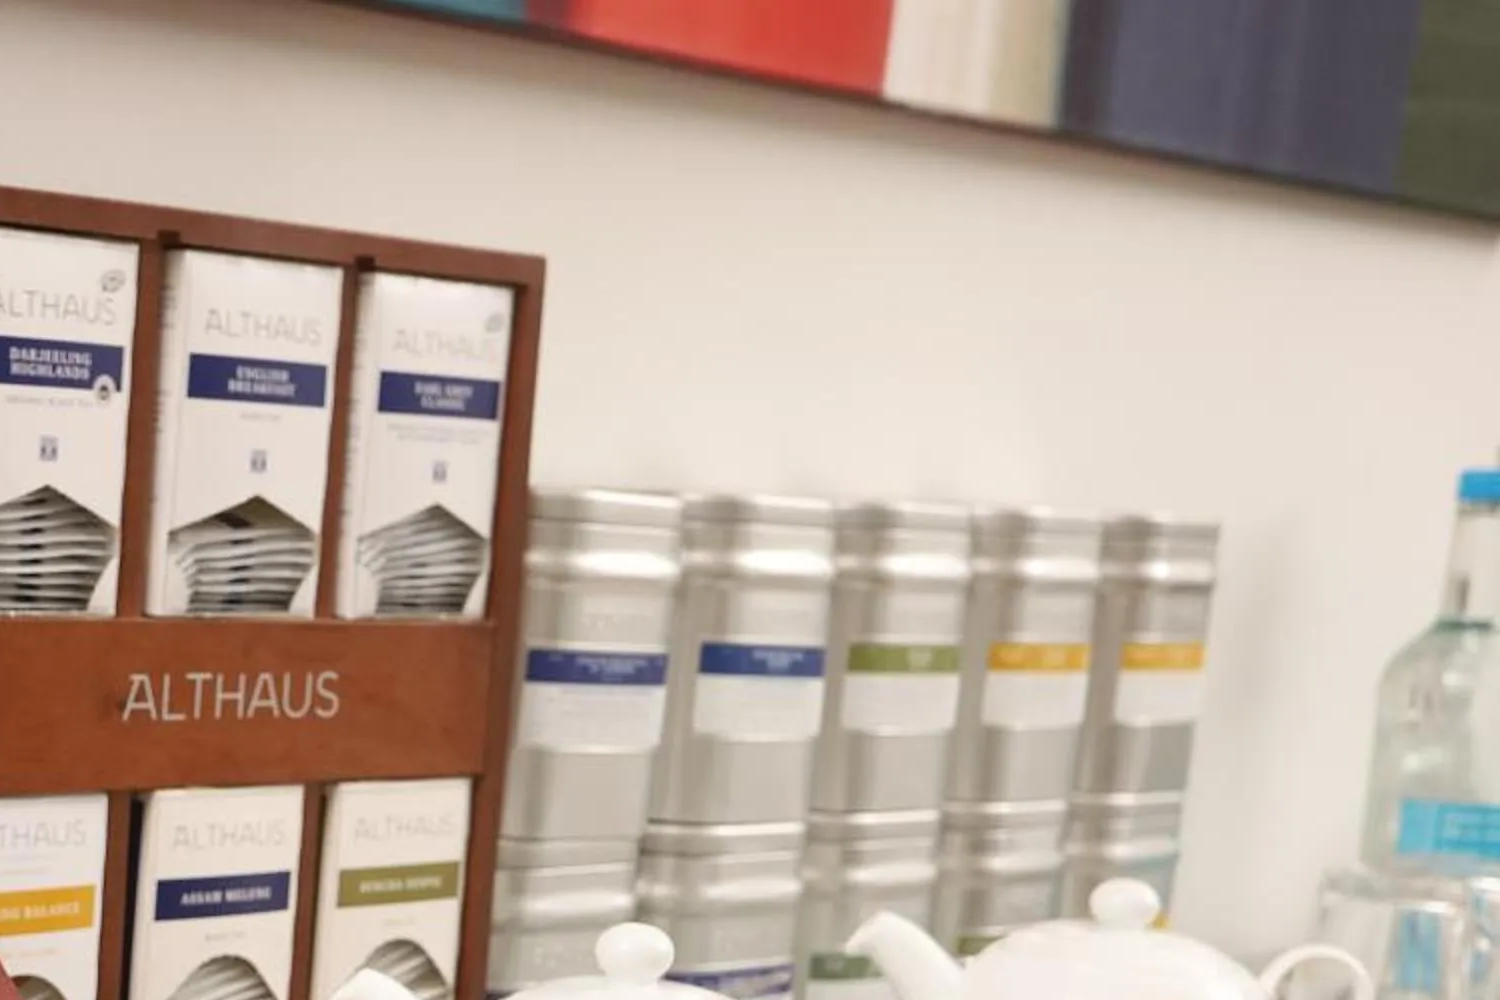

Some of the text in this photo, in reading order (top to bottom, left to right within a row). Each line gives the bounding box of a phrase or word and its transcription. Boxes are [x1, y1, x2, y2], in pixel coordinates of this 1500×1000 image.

[204, 308, 322, 347] ALTHAUS
[121, 670, 340, 722] ALTHAUS
[172, 819, 286, 851] ALTHAUS
[354, 812, 455, 842] ALTHAUS
